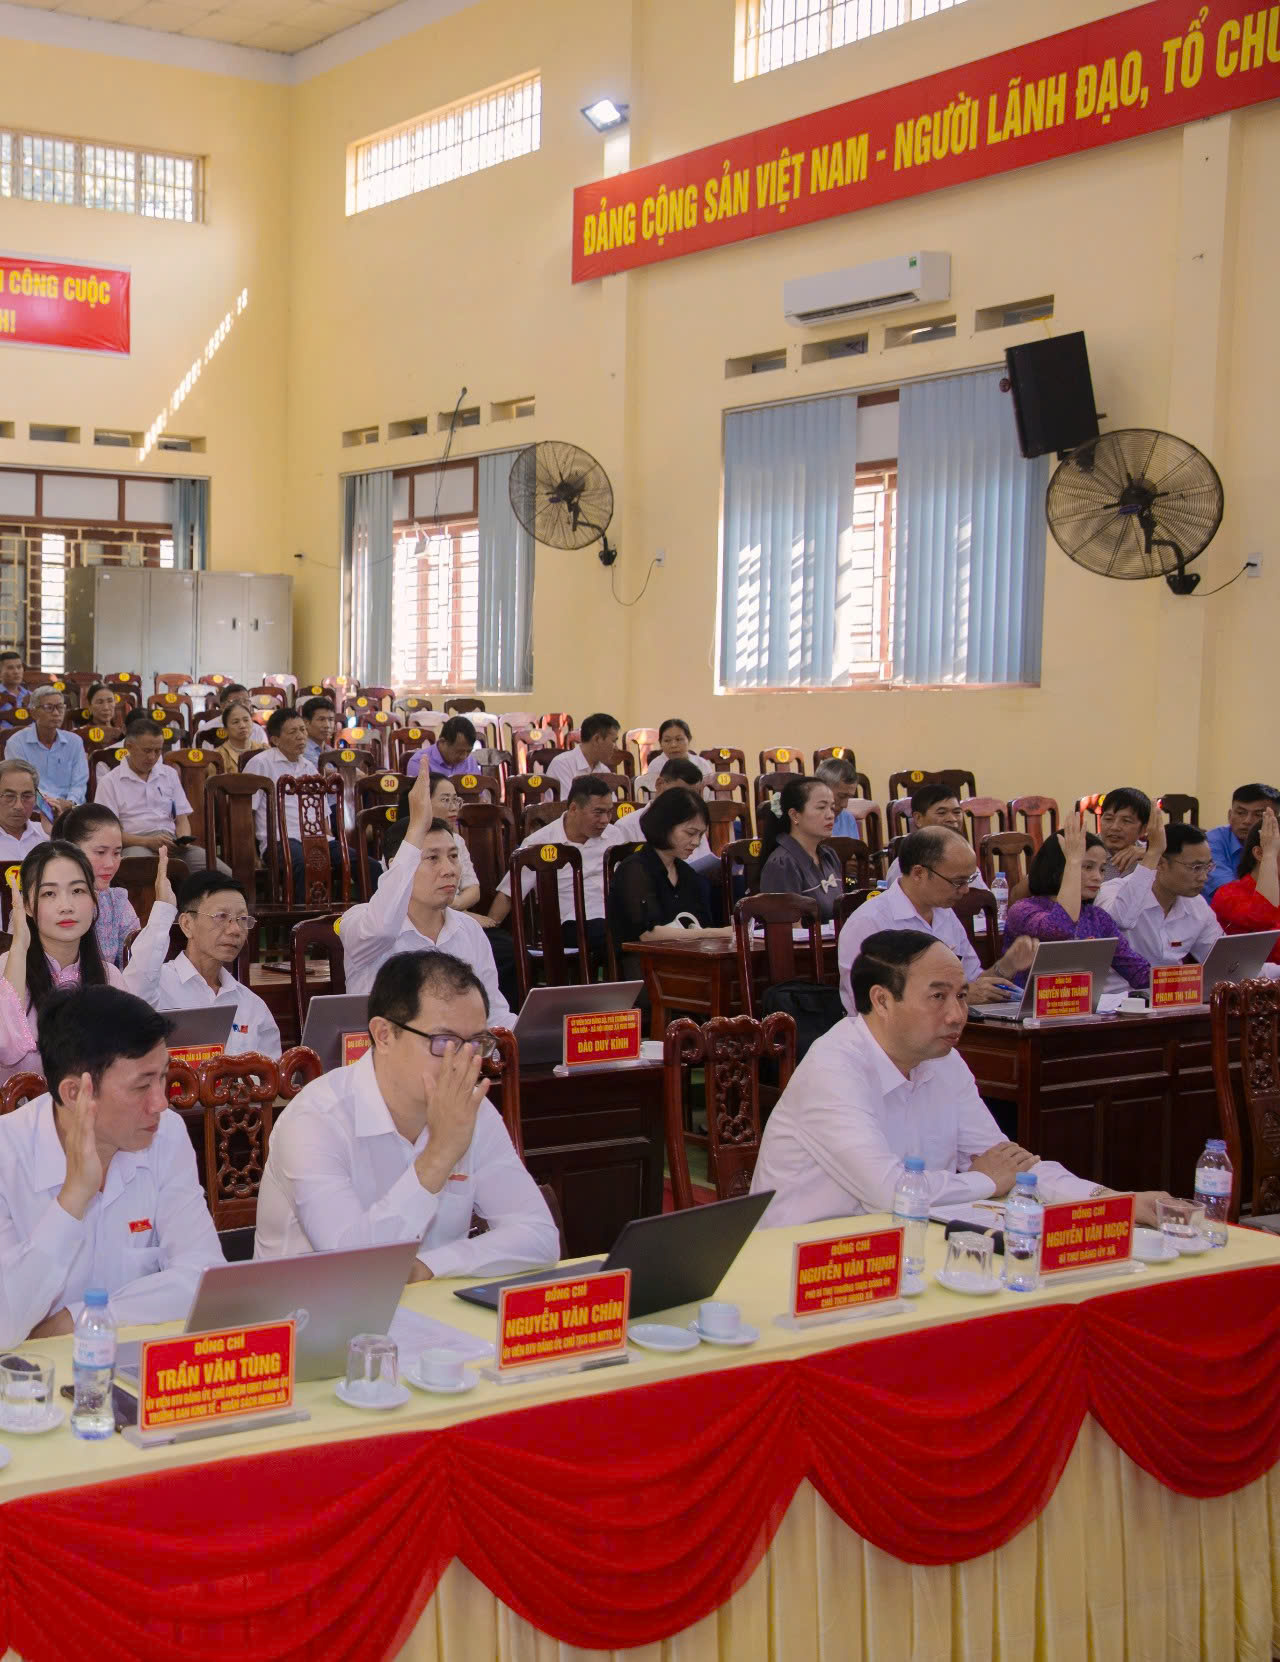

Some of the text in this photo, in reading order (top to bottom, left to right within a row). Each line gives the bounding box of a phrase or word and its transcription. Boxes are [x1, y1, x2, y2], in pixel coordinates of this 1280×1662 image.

[583, 196, 638, 256] ĐẢNG
[640, 183, 699, 244] CỘNG
[702, 160, 750, 222] SẢN
[756, 147, 804, 213] VIỆT
[808, 132, 869, 193] NAM
[893, 91, 979, 170] NGƯỜI
[986, 71, 1067, 144] LÃNH
[1075, 49, 1149, 124] ĐẠO,
[1162, 9, 1208, 93] TỔ
[9, 268, 58, 296] CÔNG
[63, 276, 110, 304] CUỘC
[544, 848, 555, 859] 112
[594, 1039, 608, 1051] DUY
[1045, 1223, 1083, 1248] NGUYỄN
[1084, 1223, 1103, 1242] VĂN
[799, 1254, 896, 1284] NGUYỄN VĂN THỊNH
[544, 1282, 587, 1302] ĐỒNG CHÍ
[505, 1307, 559, 1338] NGUYỄN
[561, 1304, 589, 1328] VĂN
[193, 1332, 244, 1355] ĐỒNG CHÍ
[156, 1351, 280, 1391] TRẦN VĂN TÙNG
